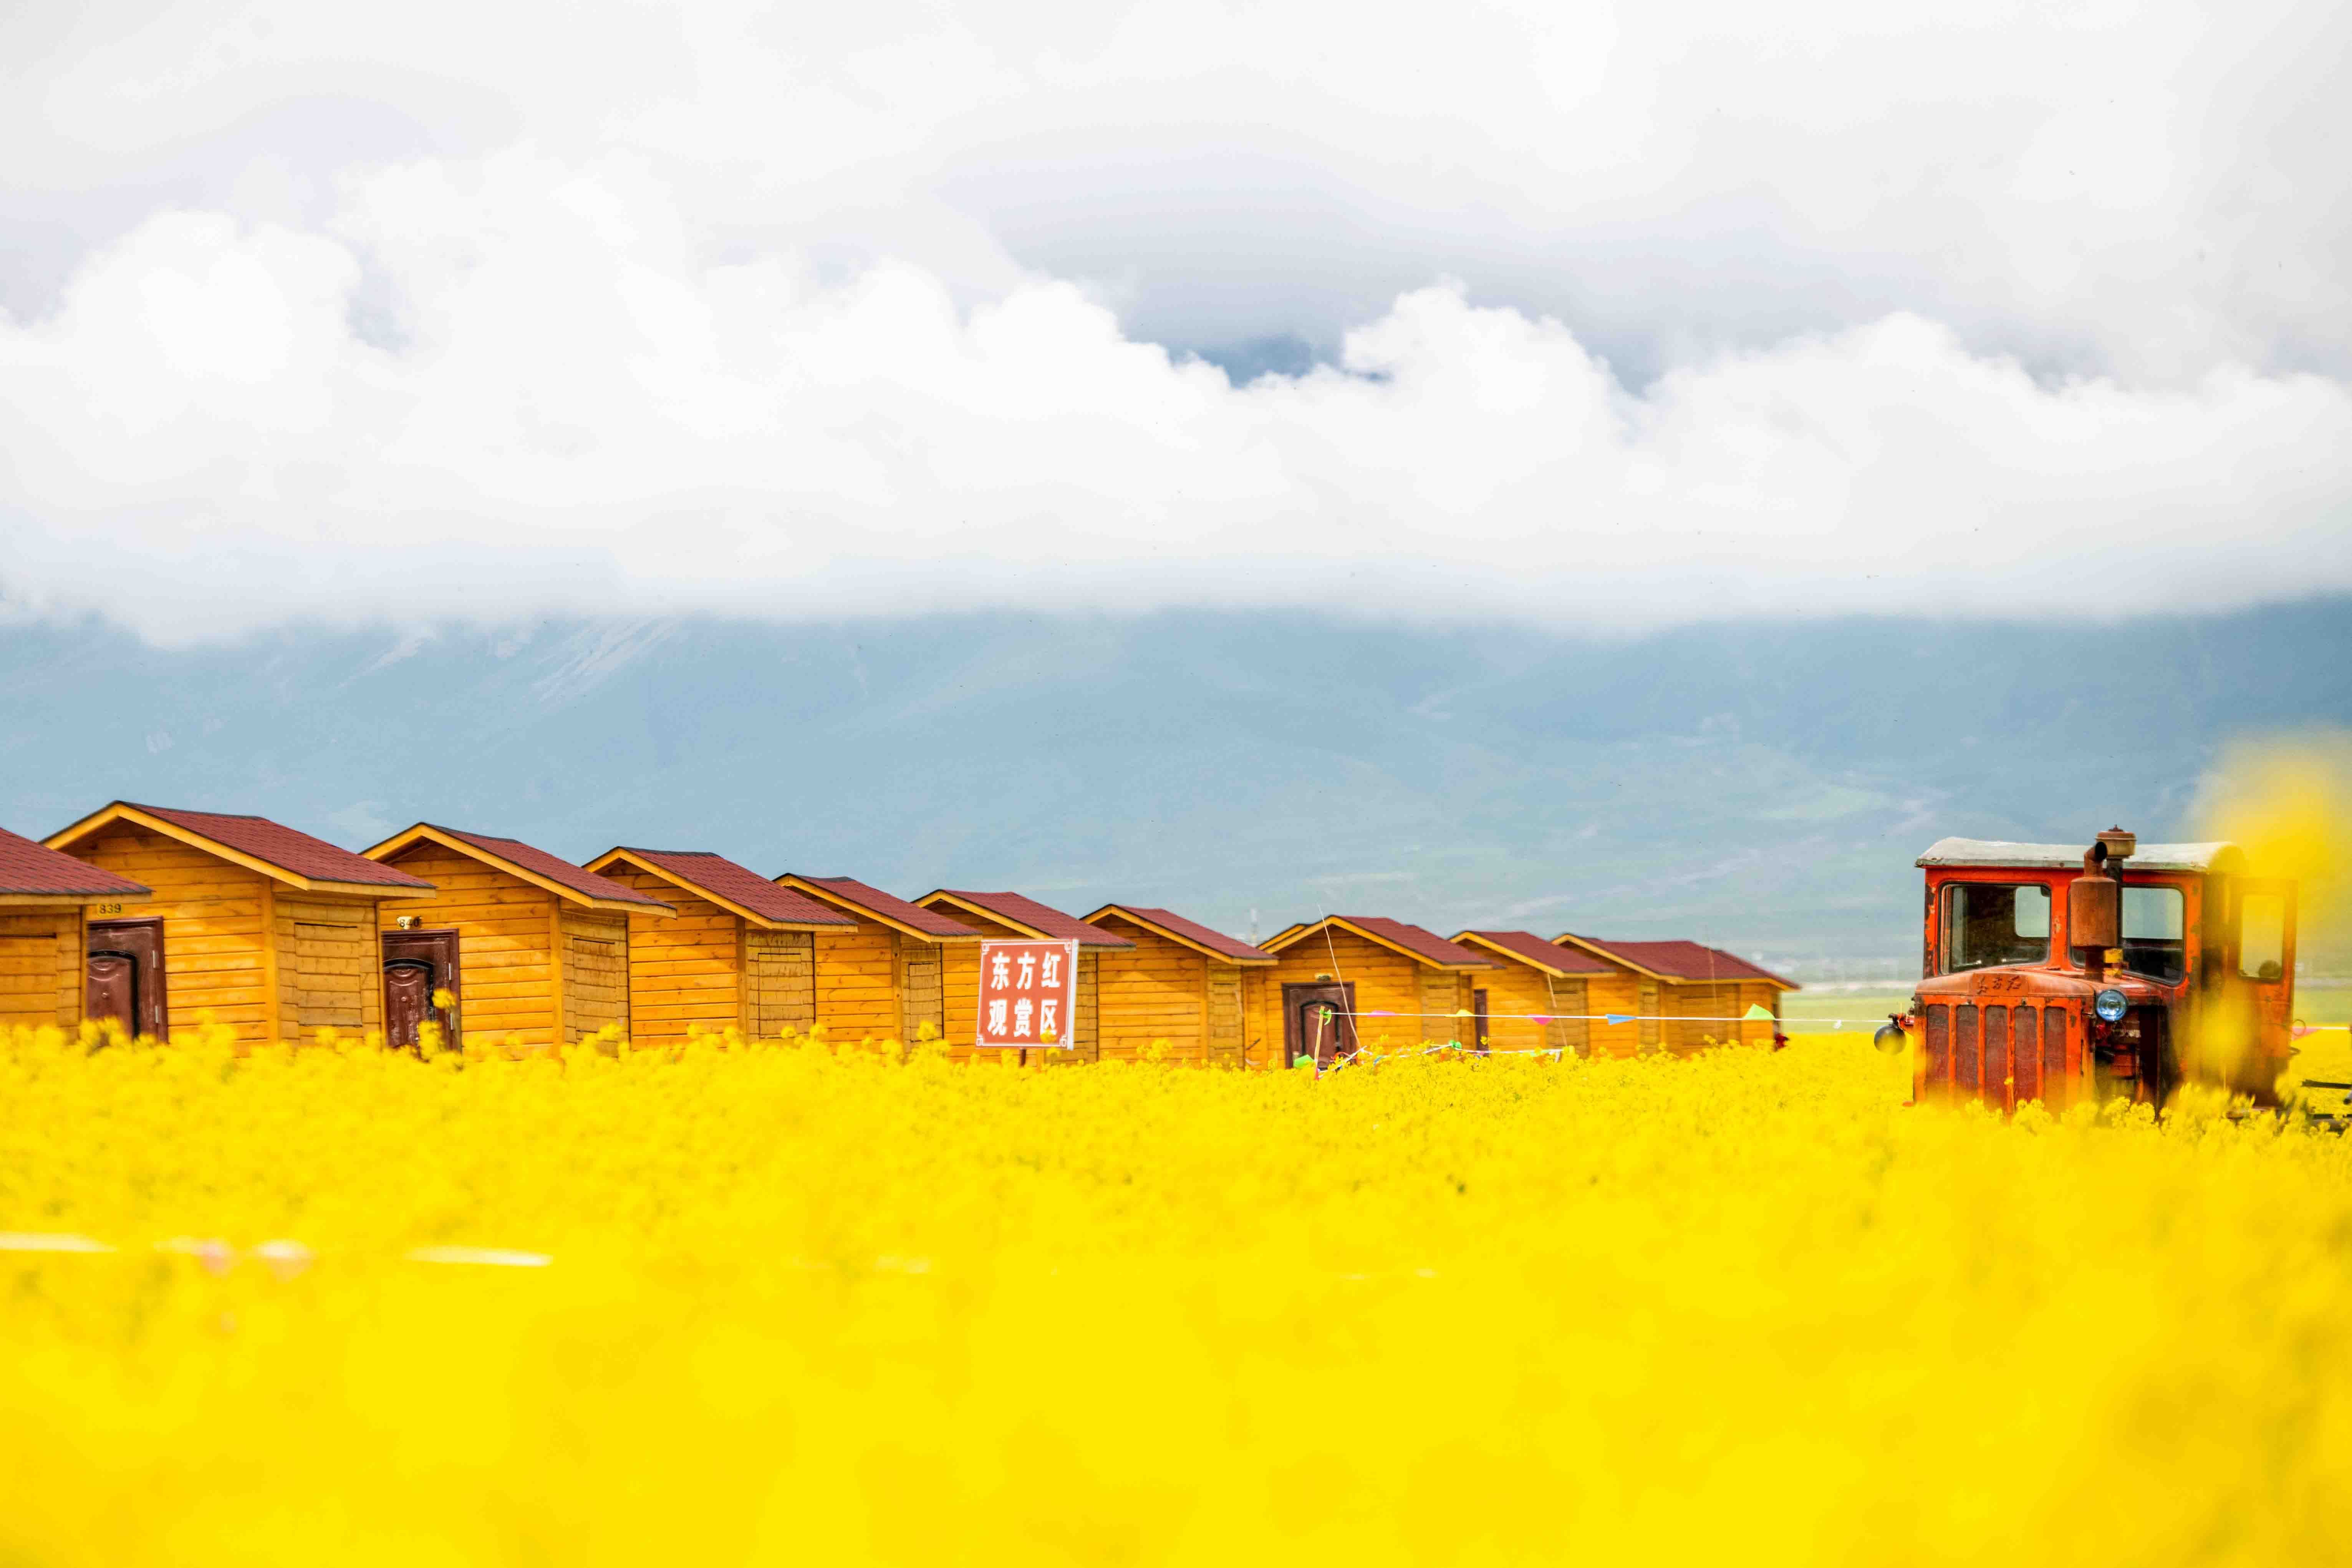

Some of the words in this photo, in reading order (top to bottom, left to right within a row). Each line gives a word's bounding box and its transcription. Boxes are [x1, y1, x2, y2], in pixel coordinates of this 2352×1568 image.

[99, 903, 121, 913] 839
[991, 951, 1062, 990] 东方红
[987, 997, 1058, 1037] 观赏区
